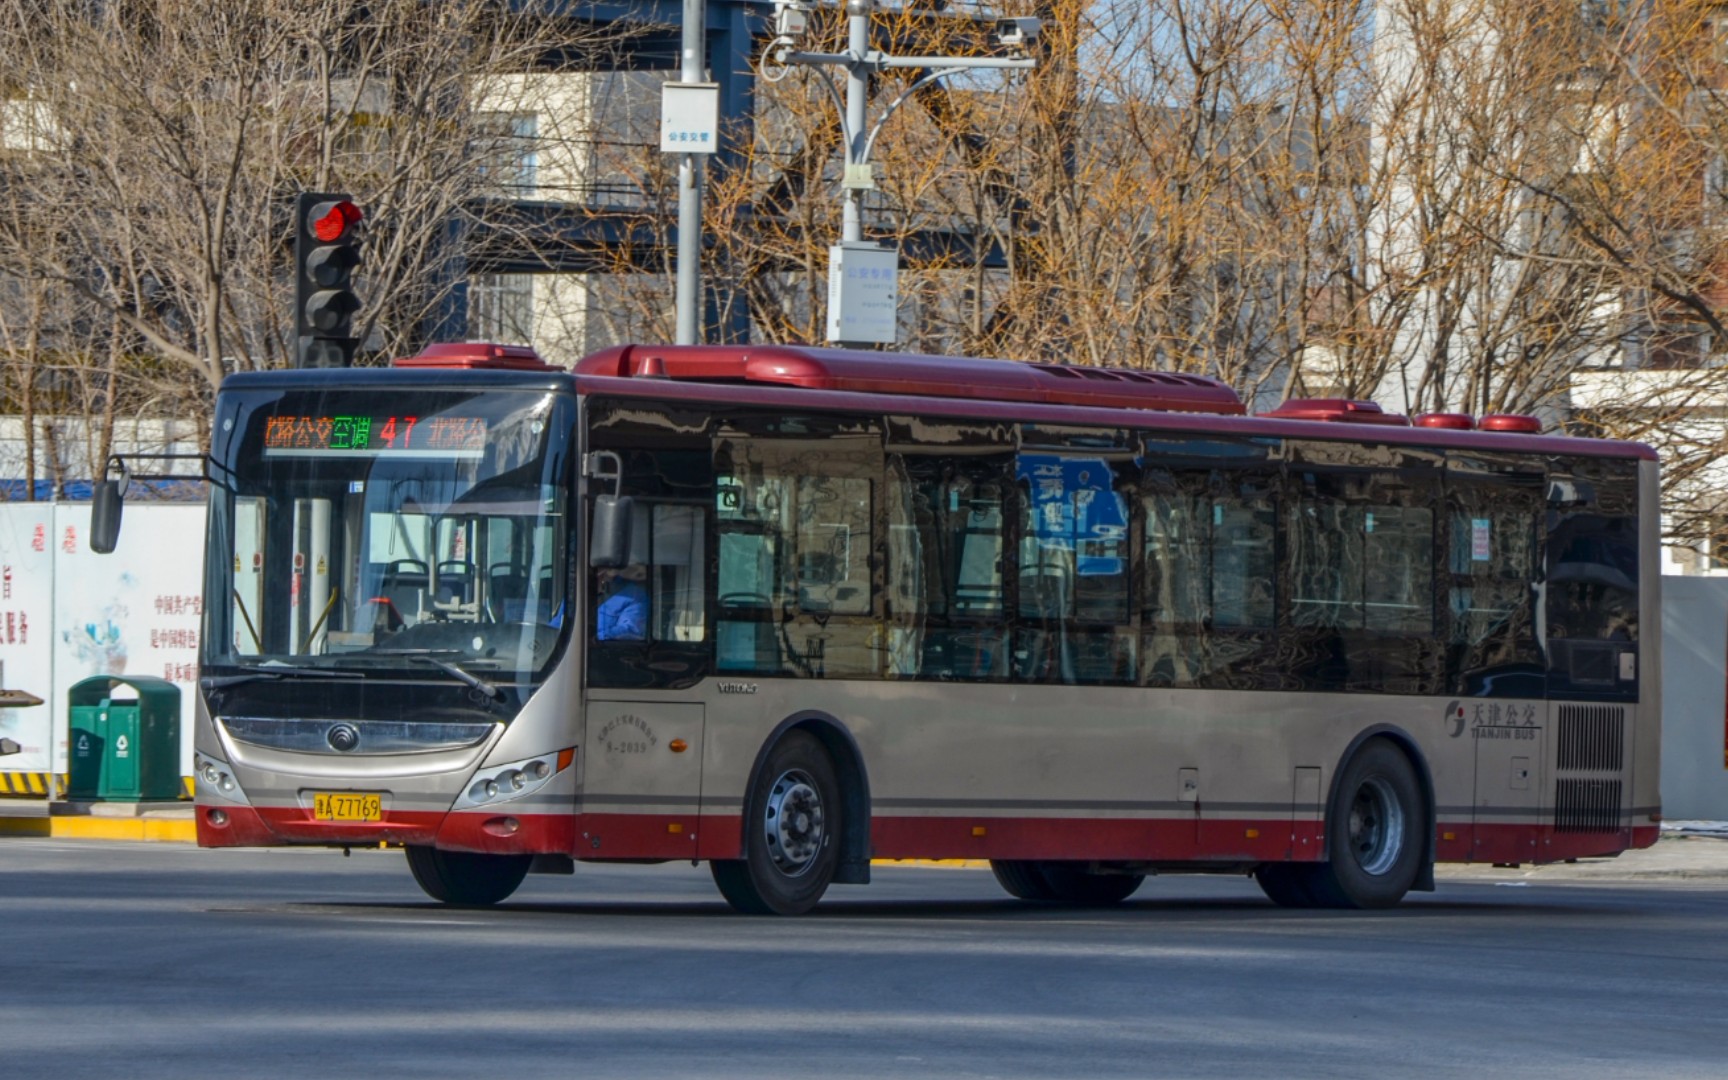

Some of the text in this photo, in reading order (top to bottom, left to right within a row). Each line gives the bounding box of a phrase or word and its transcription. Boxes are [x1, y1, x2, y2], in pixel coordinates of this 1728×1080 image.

[380, 417, 417, 448] 47
[1472, 703, 1536, 726] 天津公交
[1471, 727, 1535, 740] TIANJIN BUS
